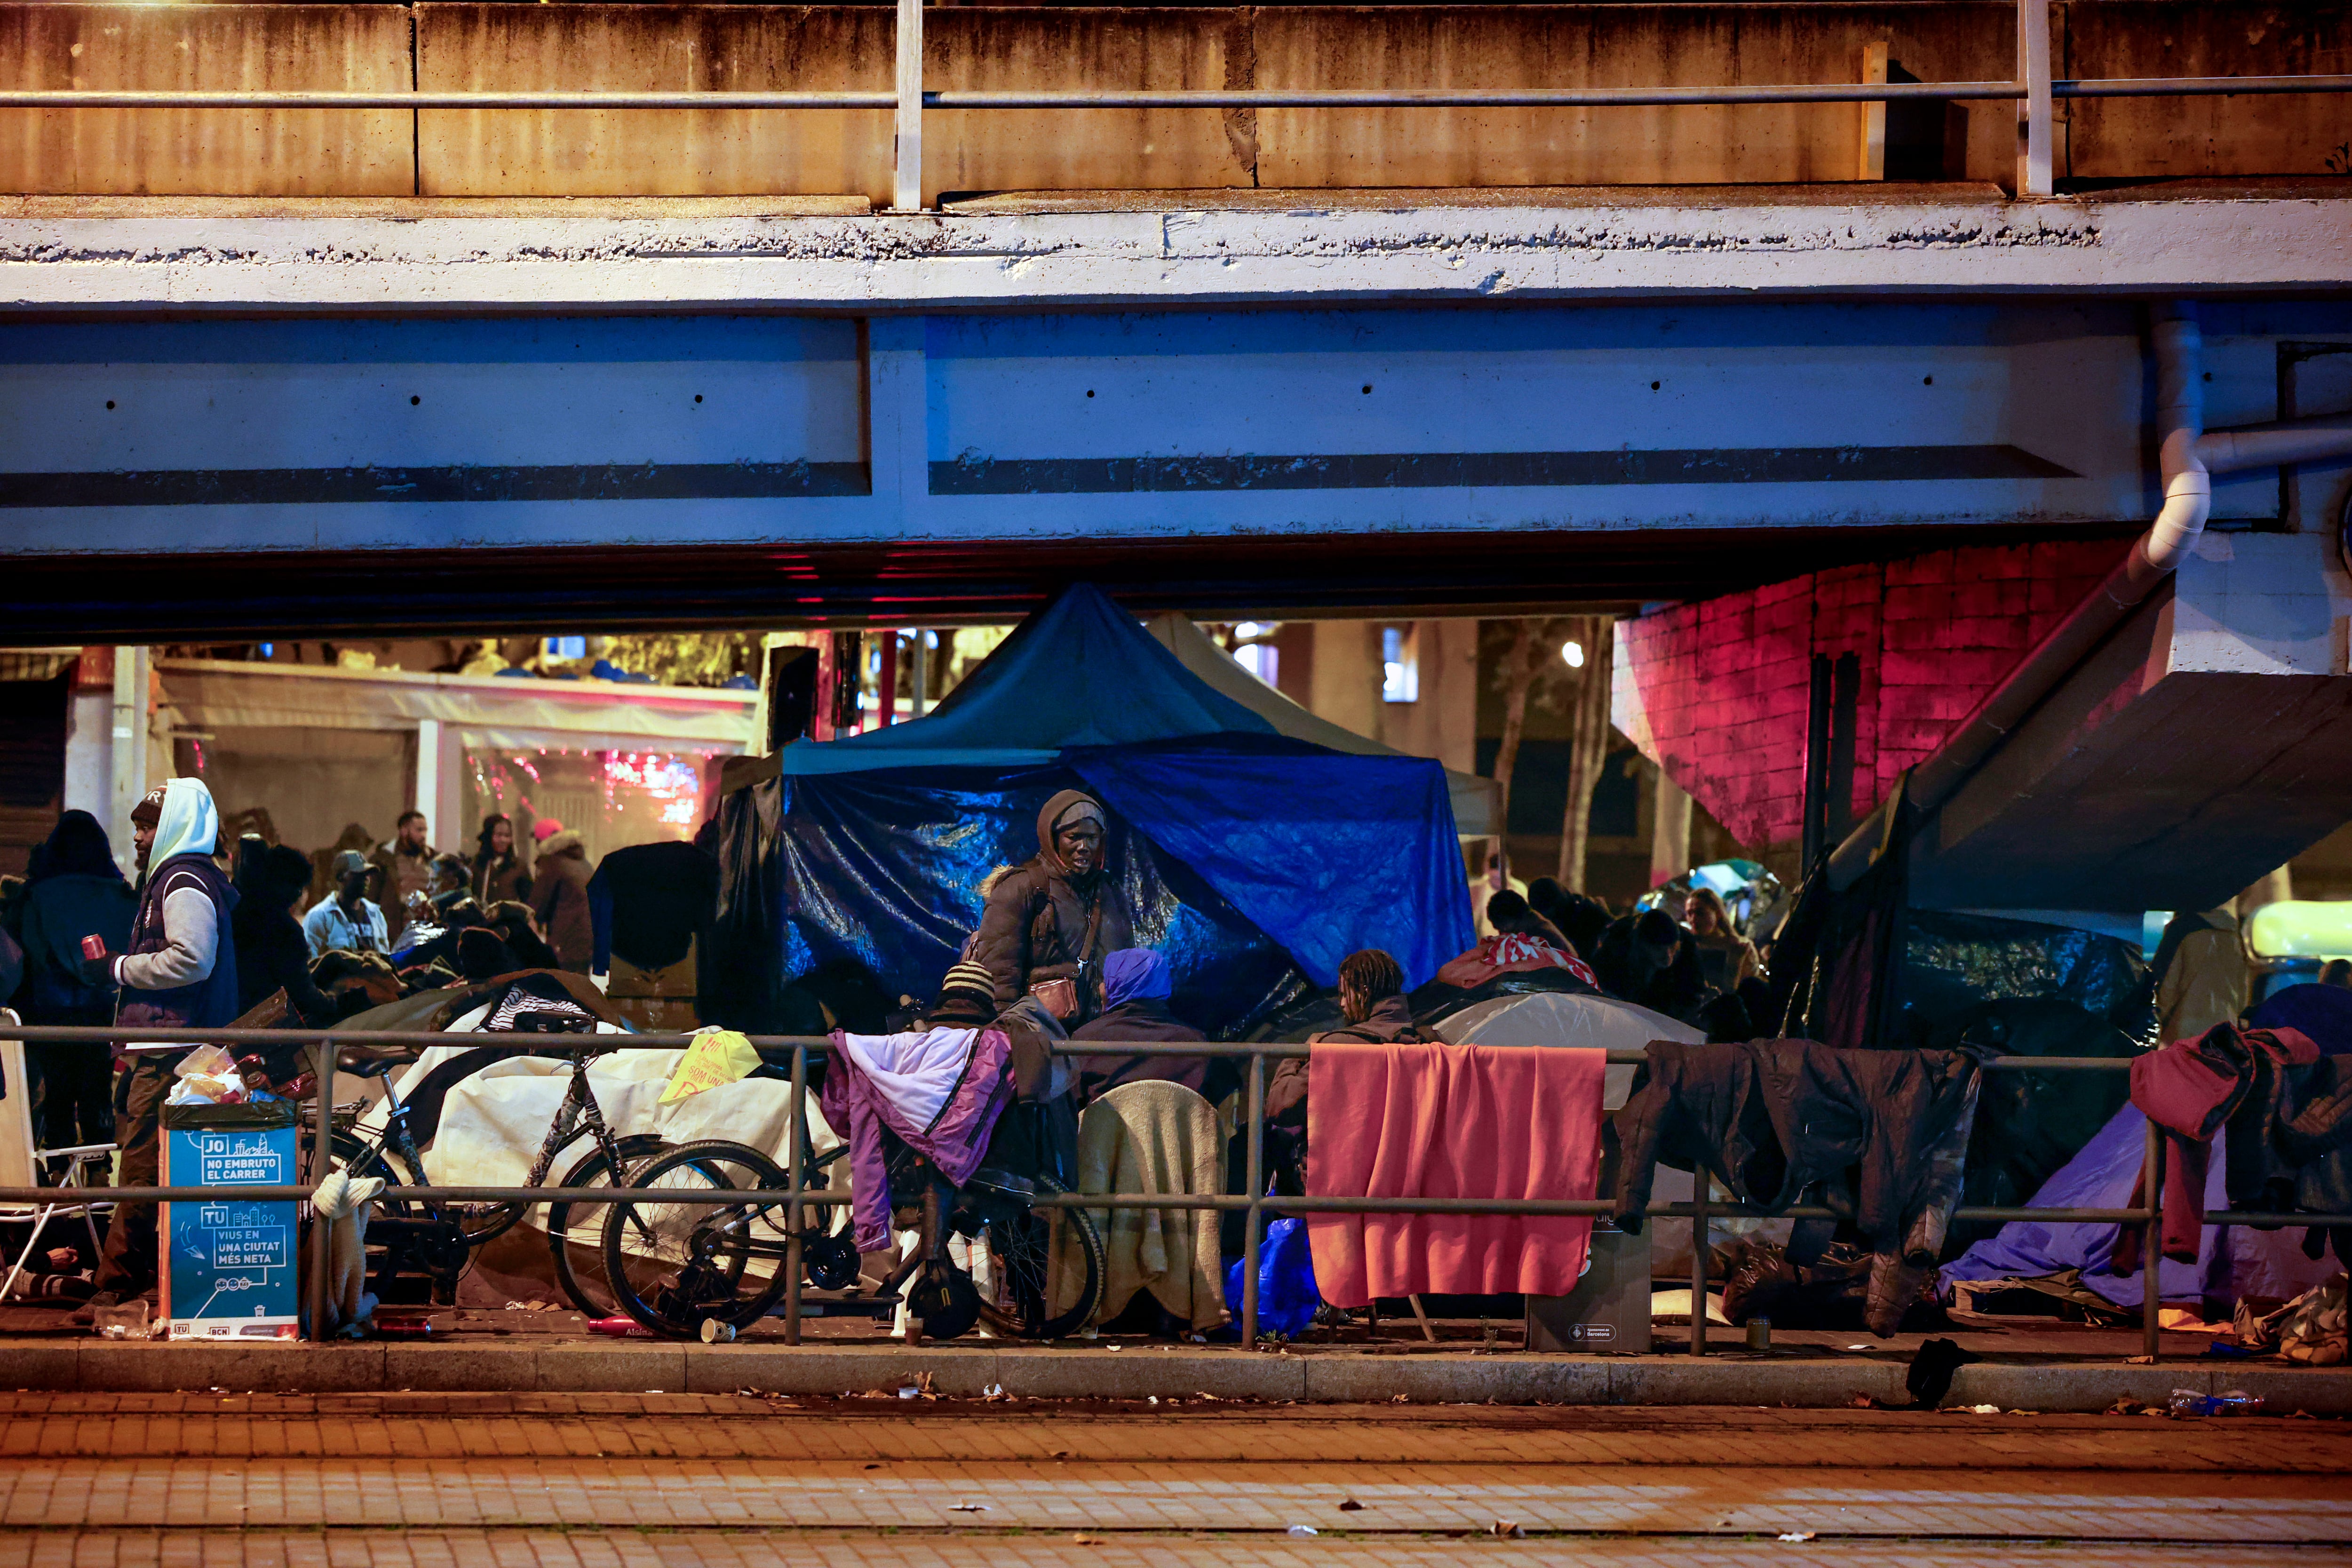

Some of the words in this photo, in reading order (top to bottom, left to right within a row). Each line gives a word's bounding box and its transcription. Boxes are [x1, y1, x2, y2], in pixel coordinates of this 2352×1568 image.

[688, 1066, 707, 1080] SOM
[707, 1075, 724, 1087] UNA
[205, 1140, 224, 1153] JO
[207, 1160, 222, 1169] NO
[224, 1158, 276, 1169] EMBRUTO
[207, 1170, 221, 1179] EL
[223, 1170, 265, 1179] CARRER
[205, 1211, 224, 1224] TU
[218, 1231, 242, 1240] VIUS
[245, 1230, 259, 1239] EN
[218, 1243, 241, 1252] UNA
[244, 1242, 280, 1251] CIUTAT
[218, 1253, 241, 1264] MÉS
[244, 1254, 271, 1264] NETA
